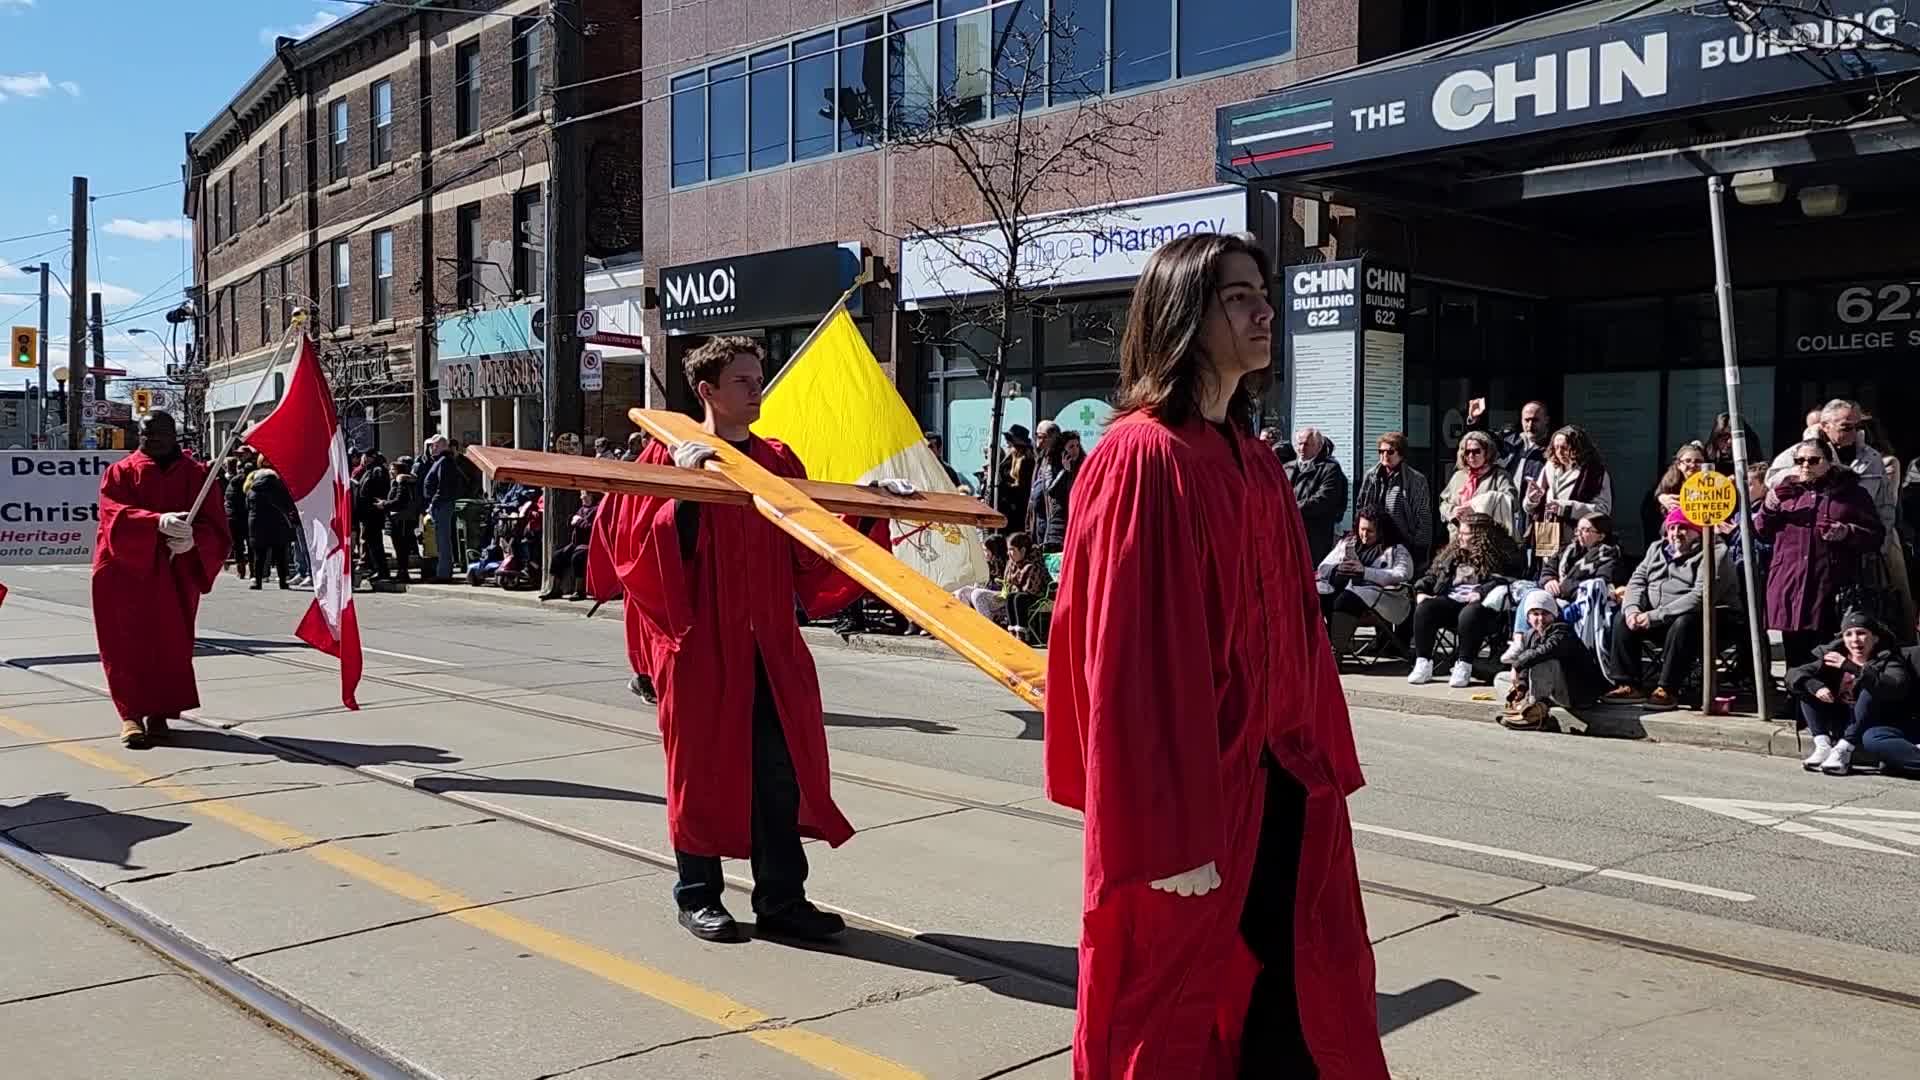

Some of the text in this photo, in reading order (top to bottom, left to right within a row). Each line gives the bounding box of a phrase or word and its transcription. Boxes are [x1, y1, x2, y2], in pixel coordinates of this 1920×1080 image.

[1351, 7, 1897, 132] THE CHIN BUILDING
[1293, 267, 1356, 295] CHIN
[1366, 267, 1406, 293] CHIN
[1293, 294, 1355, 311] BUILDING
[1365, 294, 1405, 309] BUILDING
[1837, 284, 1920, 323] 62
[665, 305, 736, 321] MEDIA GROUP
[1307, 309, 1340, 327] 622
[1375, 309, 1396, 325] 622
[1797, 332, 1895, 352] COLLEGE
[11, 456, 110, 476] Death
[1697, 476, 1715, 488] NO
[0, 502, 100, 522] Christ
[1685, 502, 1730, 512] BETWEEN
[1692, 511, 1722, 520] SIGNS
[0, 530, 82, 544] Heritage
[38, 545, 89, 556] Canada
